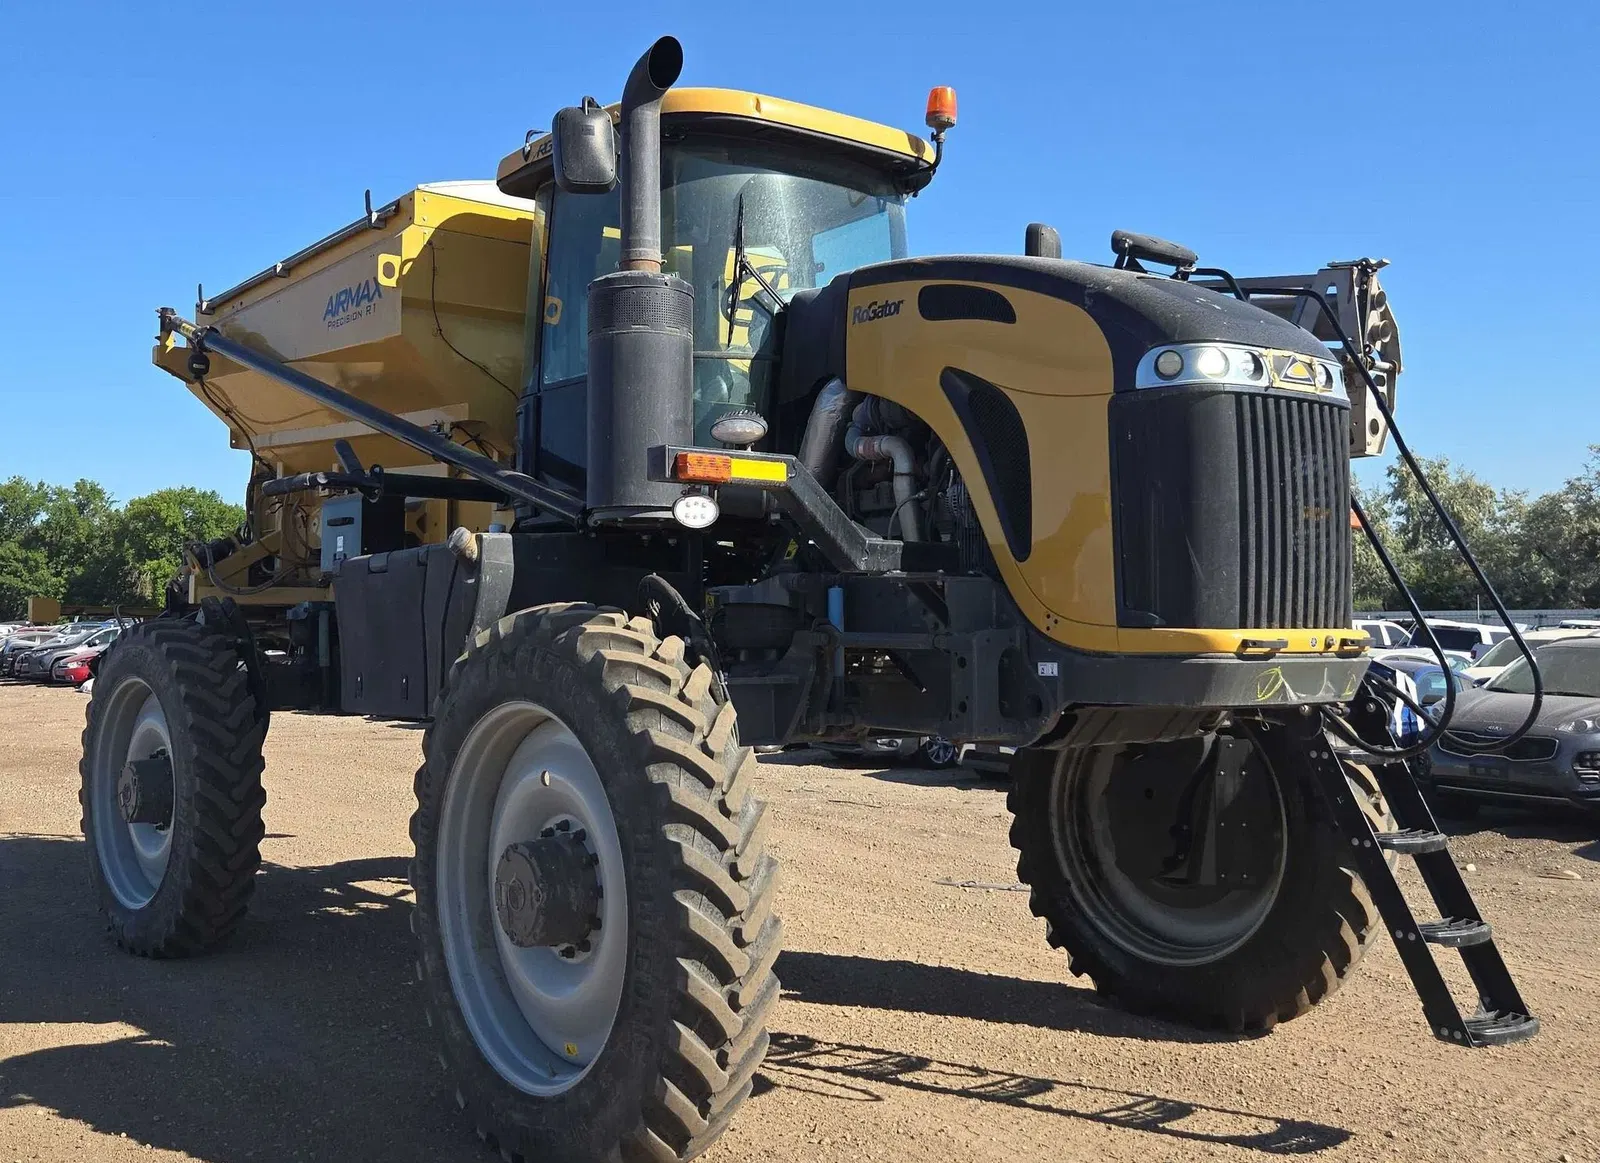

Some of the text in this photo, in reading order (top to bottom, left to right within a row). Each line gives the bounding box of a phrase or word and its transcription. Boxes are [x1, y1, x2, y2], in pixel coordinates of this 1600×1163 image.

[323, 276, 382, 321] AIRMAX
[327, 310, 363, 331] PRECISION
[852, 299, 905, 326] RoGator
